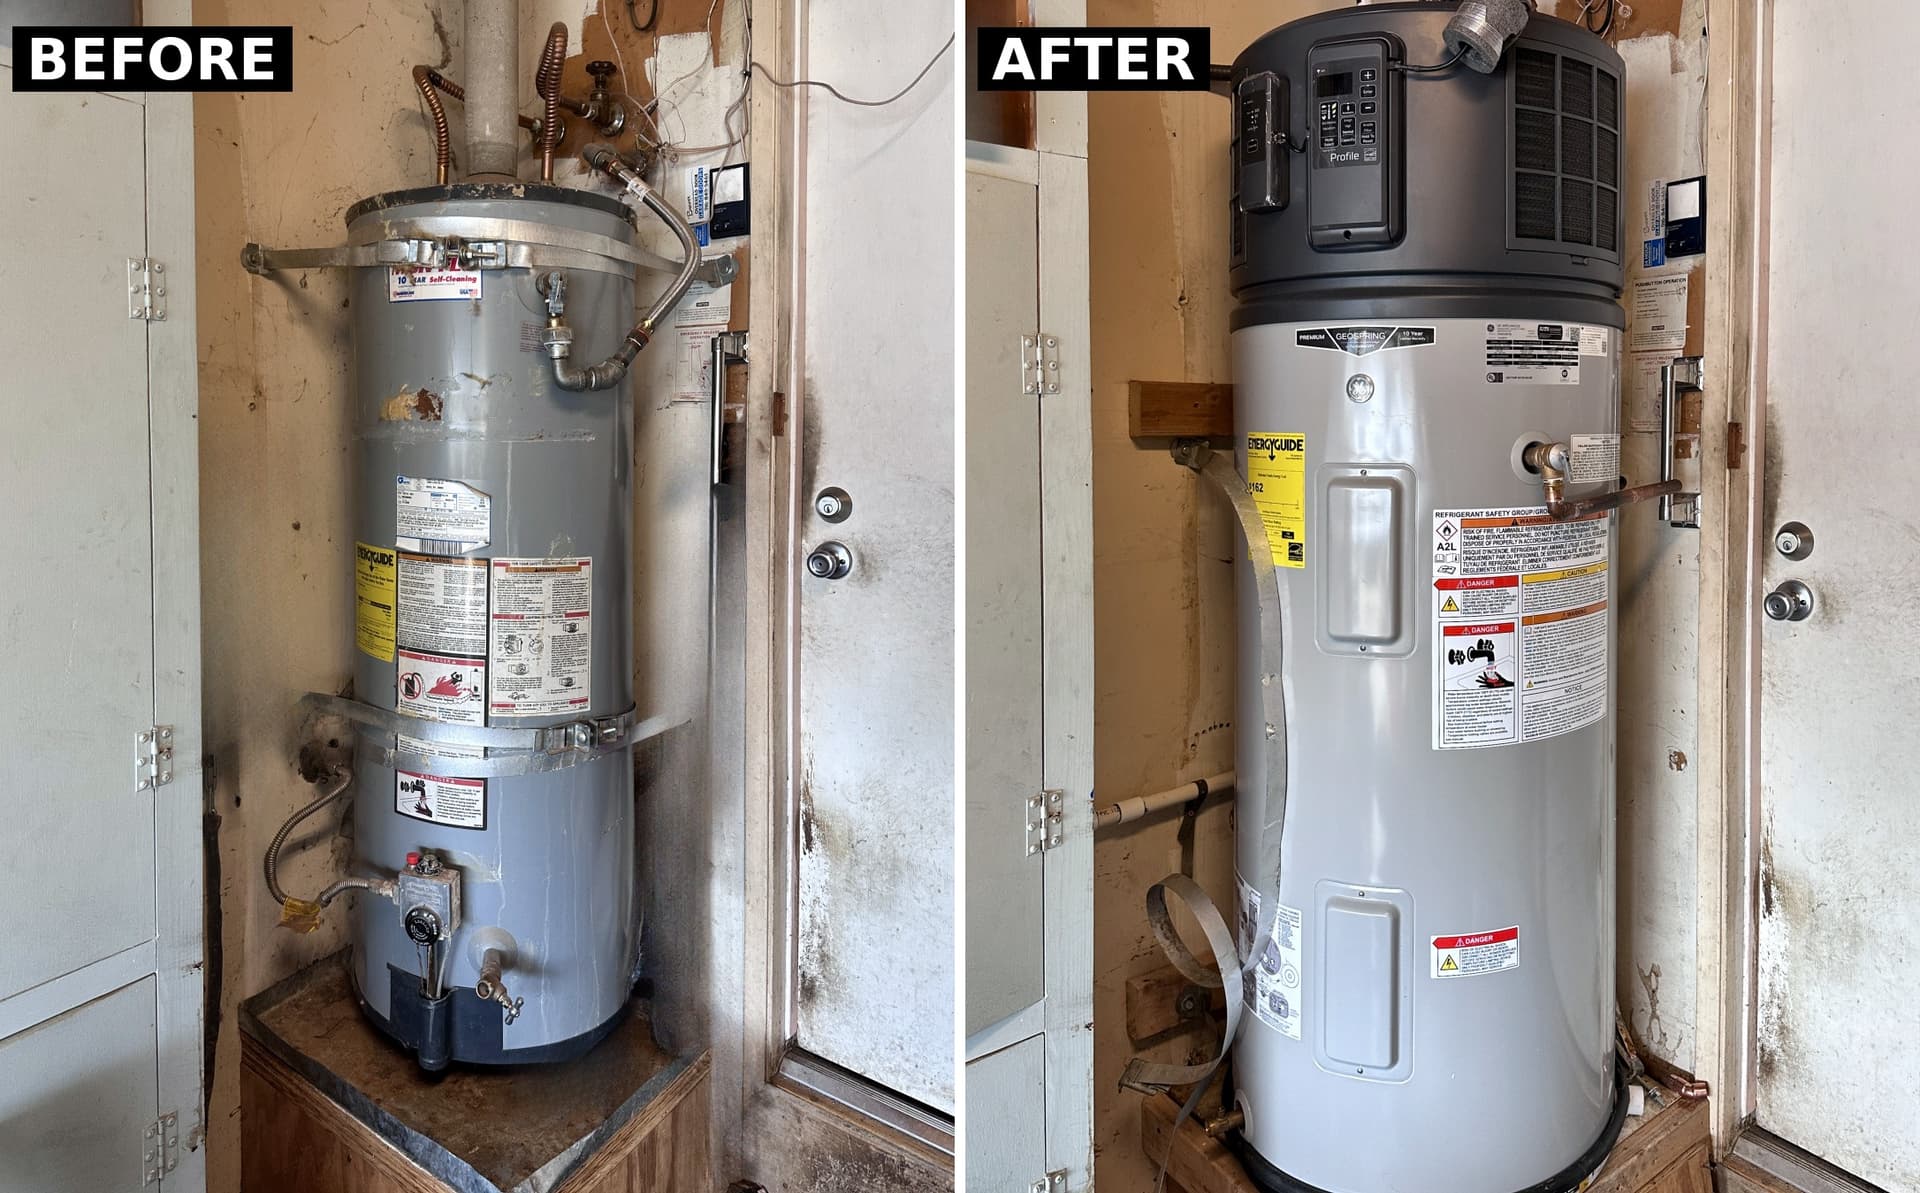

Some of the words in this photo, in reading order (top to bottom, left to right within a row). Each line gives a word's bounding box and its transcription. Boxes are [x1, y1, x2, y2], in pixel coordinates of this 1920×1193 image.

[1330, 152, 1360, 162] Profile
[398, 276, 406, 284] 10
[429, 275, 477, 284] Self-Cleaning
[1335, 332, 1386, 341] GEOSPRING
[1248, 438, 1304, 453] ENERGYGUIDE
[1436, 543, 1457, 551] A2L
[1567, 568, 1588, 576] CAUTION
[1466, 579, 1495, 587] DANGER
[1471, 625, 1500, 633] DANGER
[1564, 684, 1582, 694] NOTICE
[1465, 935, 1494, 945] DANGER
